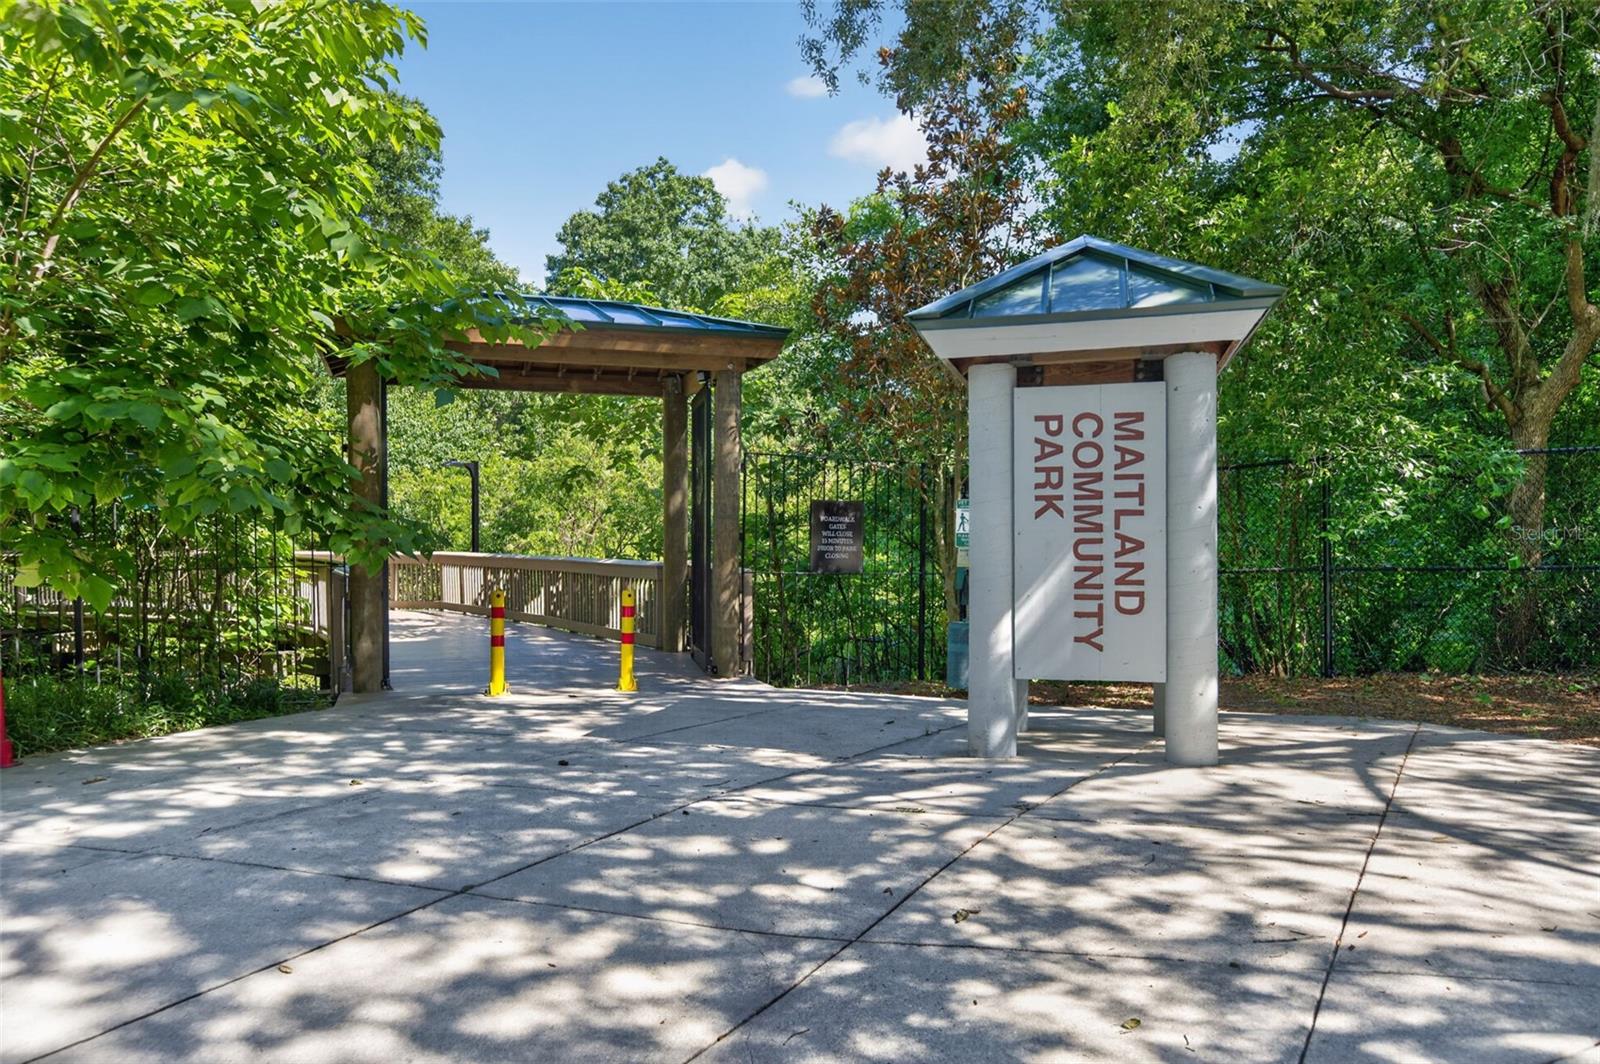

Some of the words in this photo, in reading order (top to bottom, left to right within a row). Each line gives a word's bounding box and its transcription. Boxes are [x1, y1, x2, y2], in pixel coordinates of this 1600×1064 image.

[1034, 414, 1064, 520] PARK
[1072, 411, 1104, 652] COMMUNITY
[1113, 411, 1145, 615] MAITLAND
